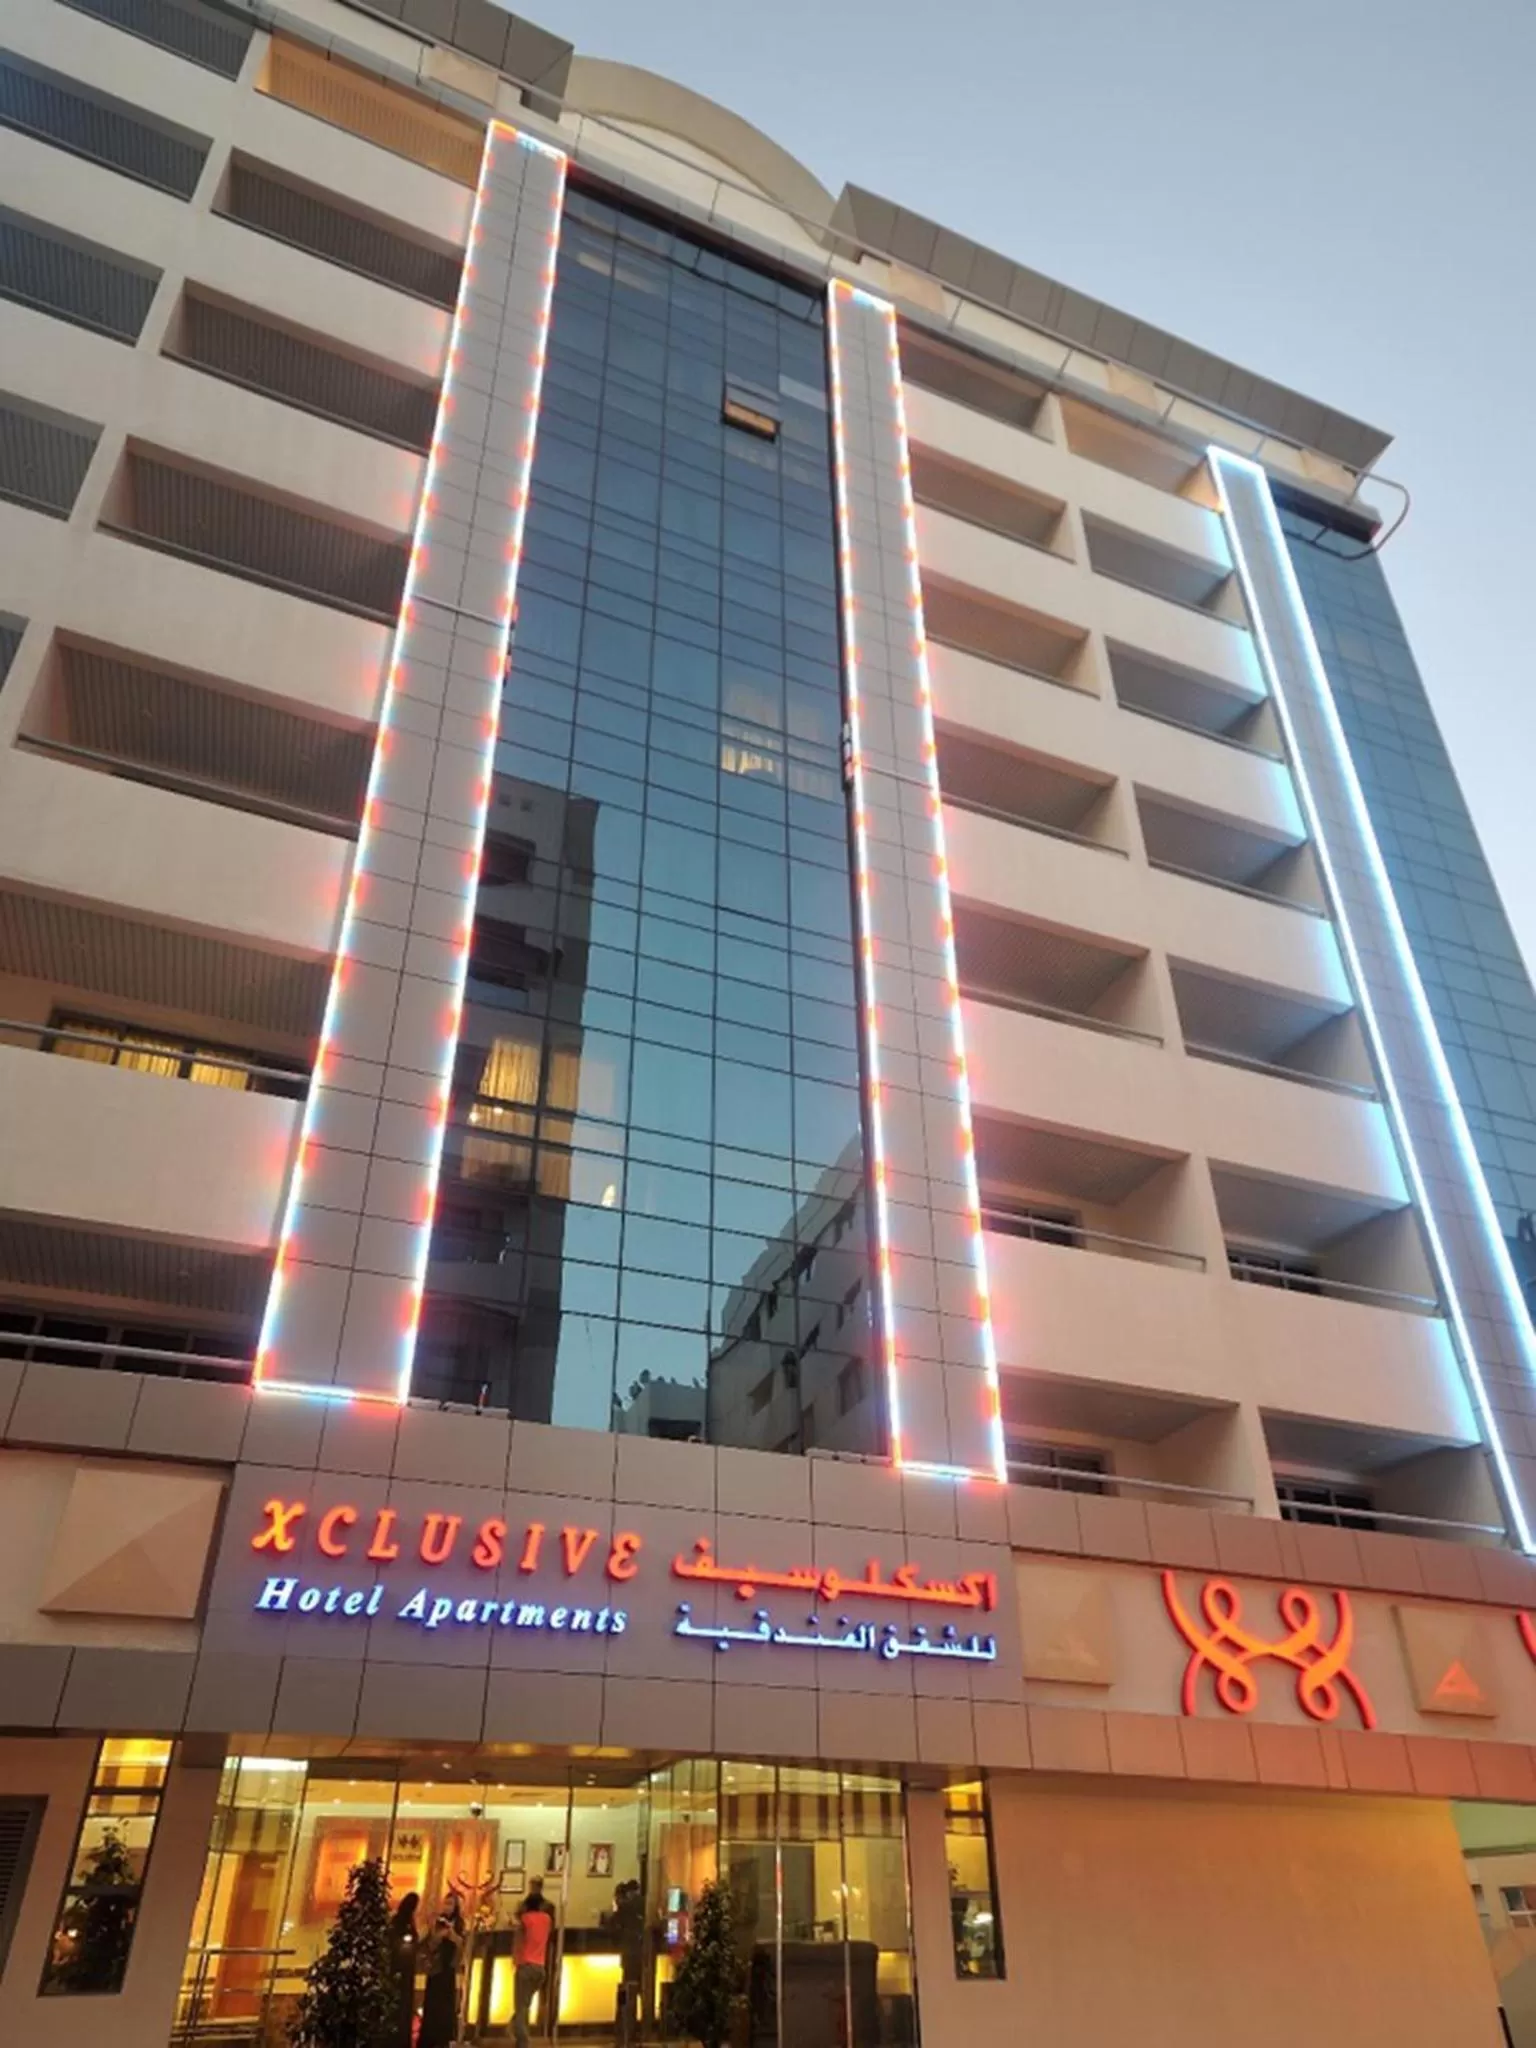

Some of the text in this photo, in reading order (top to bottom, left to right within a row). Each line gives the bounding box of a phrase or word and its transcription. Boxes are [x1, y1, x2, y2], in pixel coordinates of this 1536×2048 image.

[252, 1498, 641, 1581] XCLUSIVE
[256, 1577, 628, 1634] Hotel Apartments
[671, 1537, 996, 1612] اكسكلوسيف
[674, 1602, 876, 1650] الفندقية
